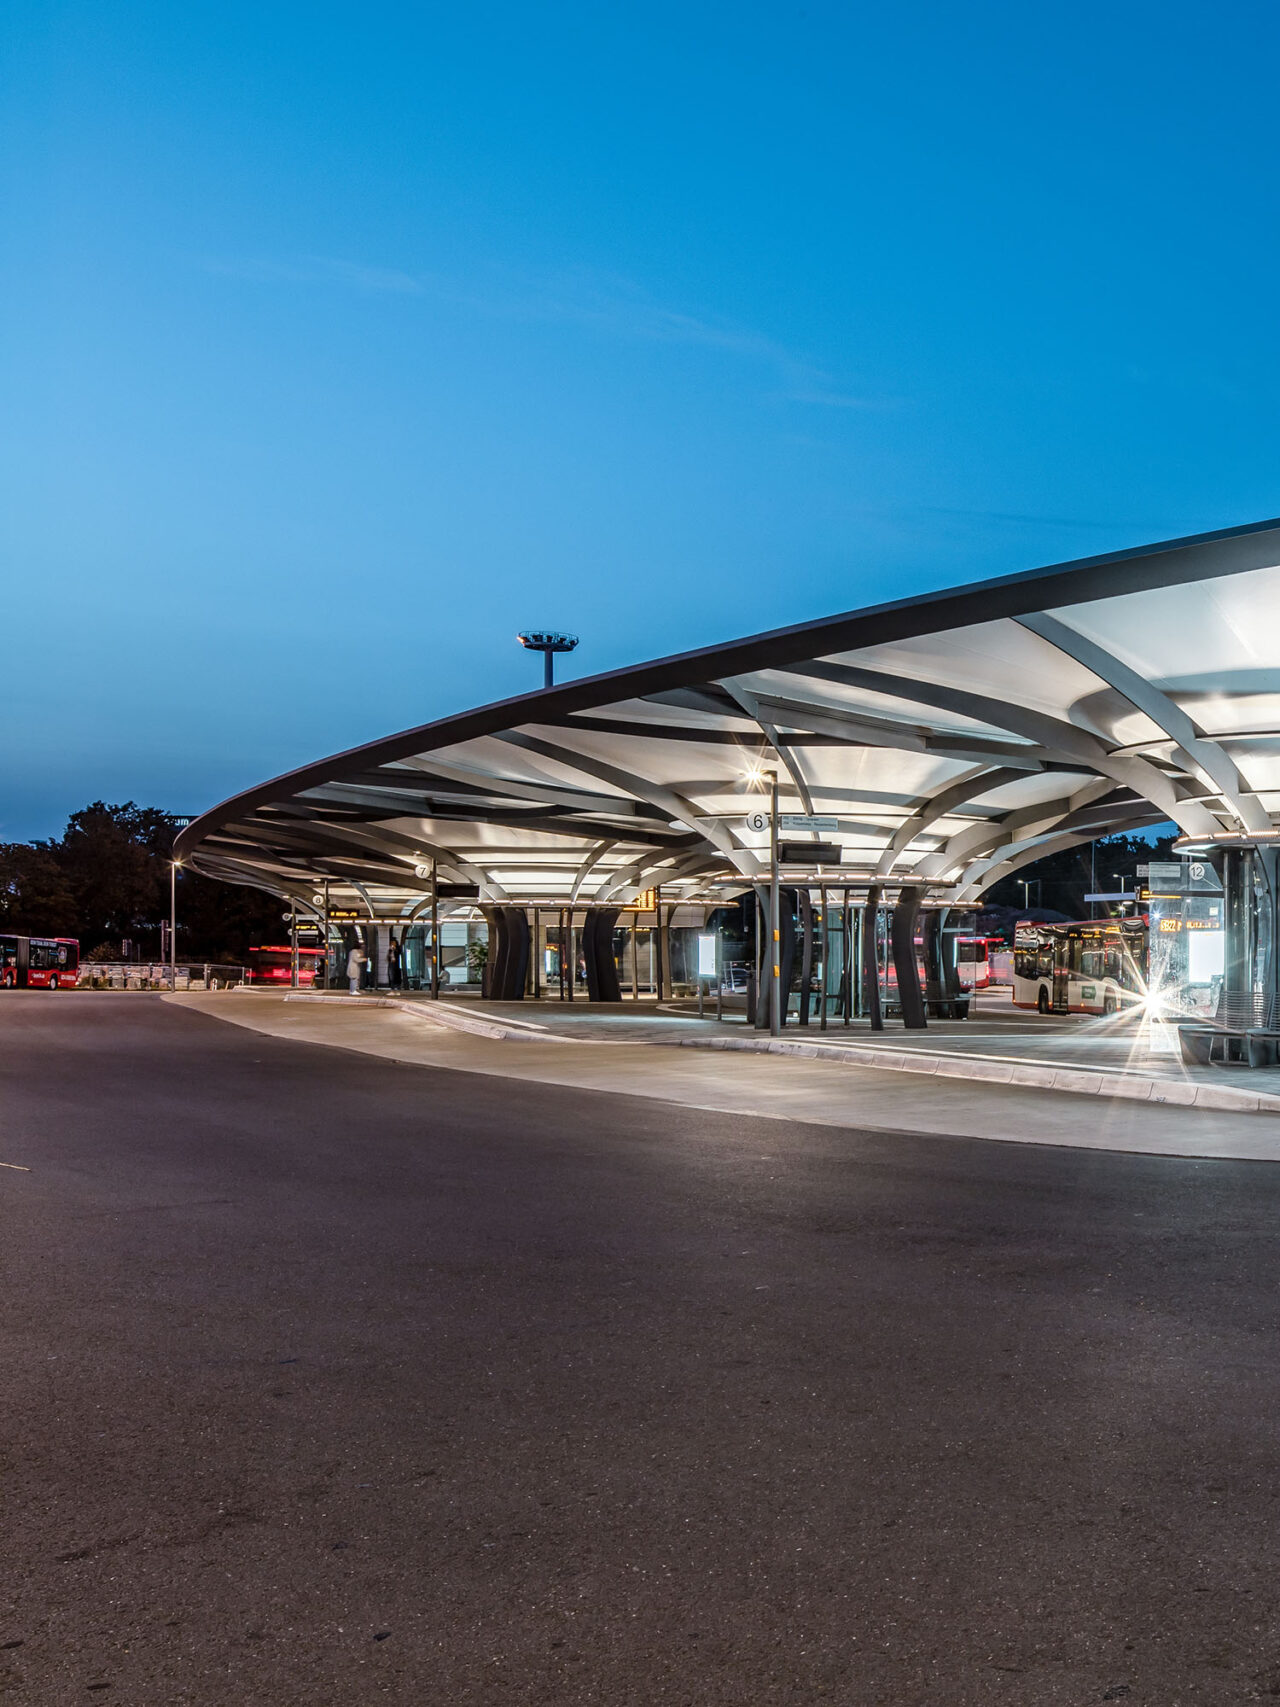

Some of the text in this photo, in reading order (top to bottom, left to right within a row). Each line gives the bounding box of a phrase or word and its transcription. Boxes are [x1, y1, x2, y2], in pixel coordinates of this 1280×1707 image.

[753, 814, 763, 829] 6
[420, 867, 427, 877] 7
[1191, 866, 1203, 877] 12
